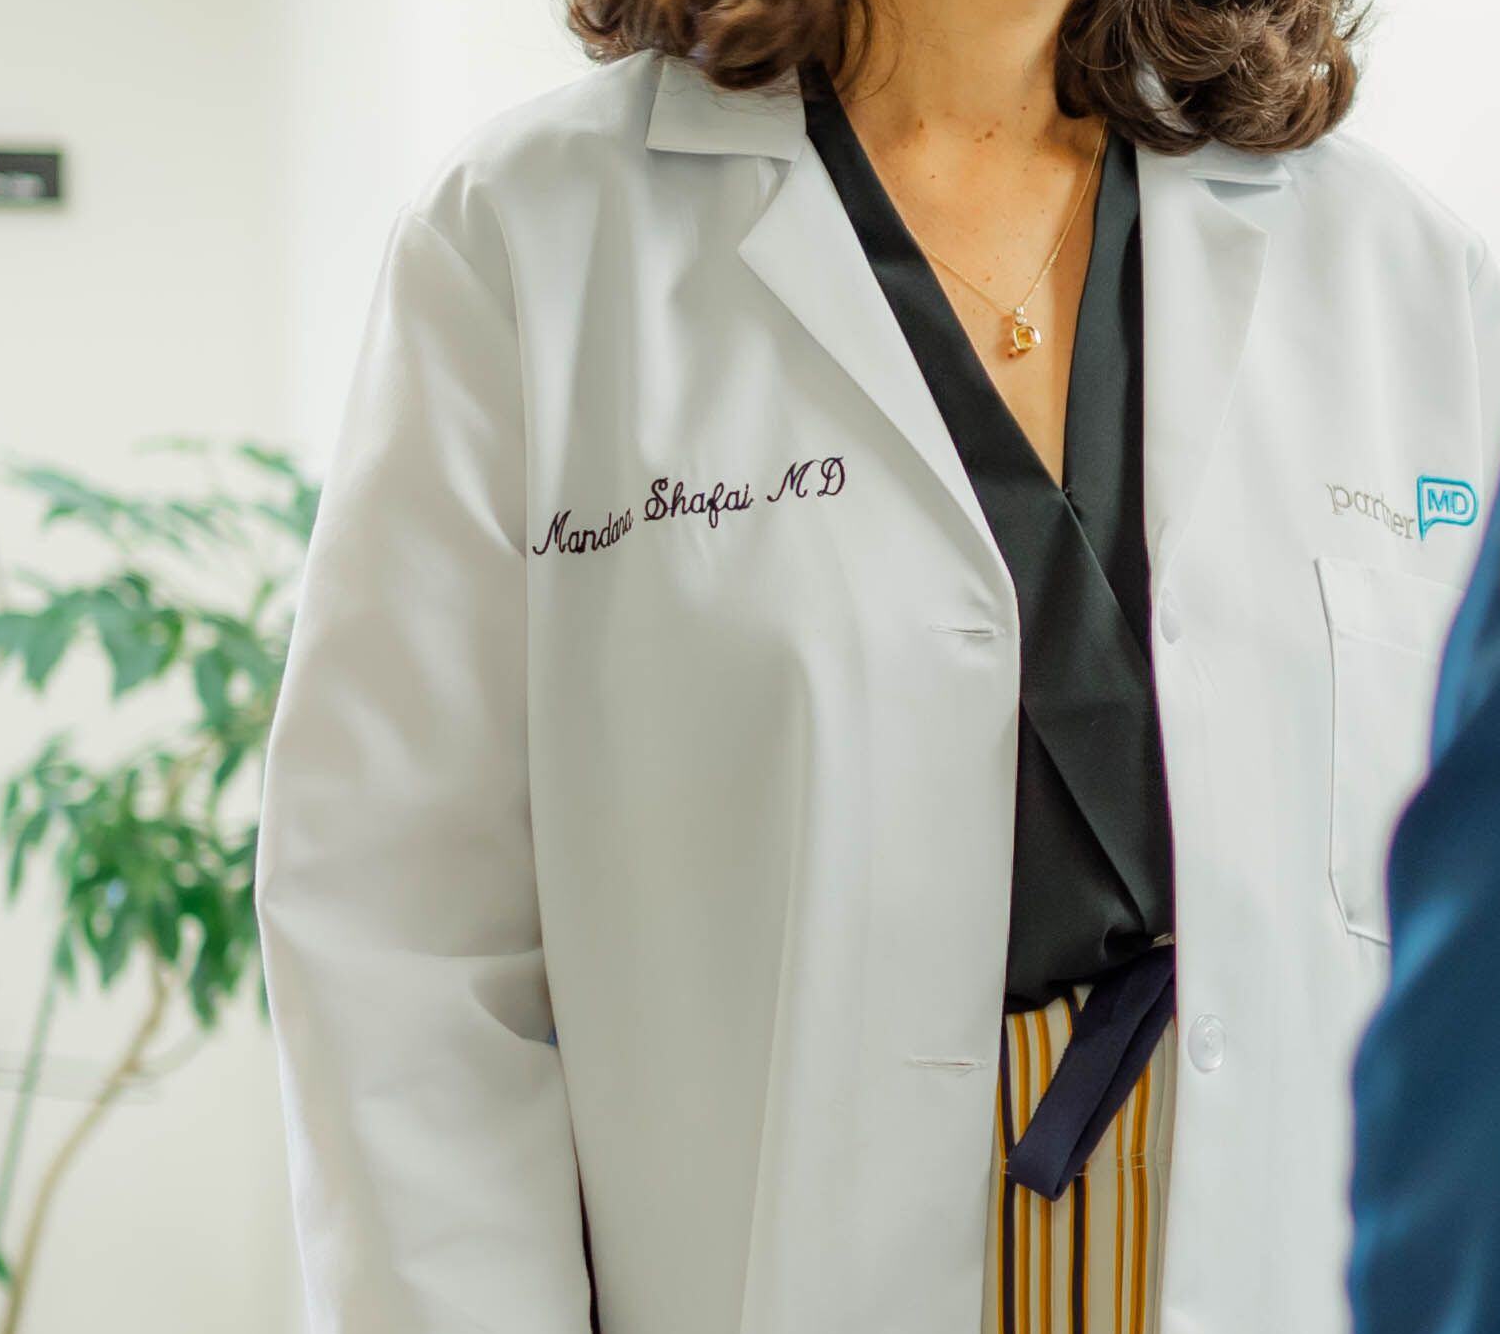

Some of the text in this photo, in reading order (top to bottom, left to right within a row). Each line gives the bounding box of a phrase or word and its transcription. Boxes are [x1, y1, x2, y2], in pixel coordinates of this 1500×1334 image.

[532, 508, 634, 555] Mandana
[644, 477, 754, 529] Shafai
[1426, 488, 1470, 516] MD
